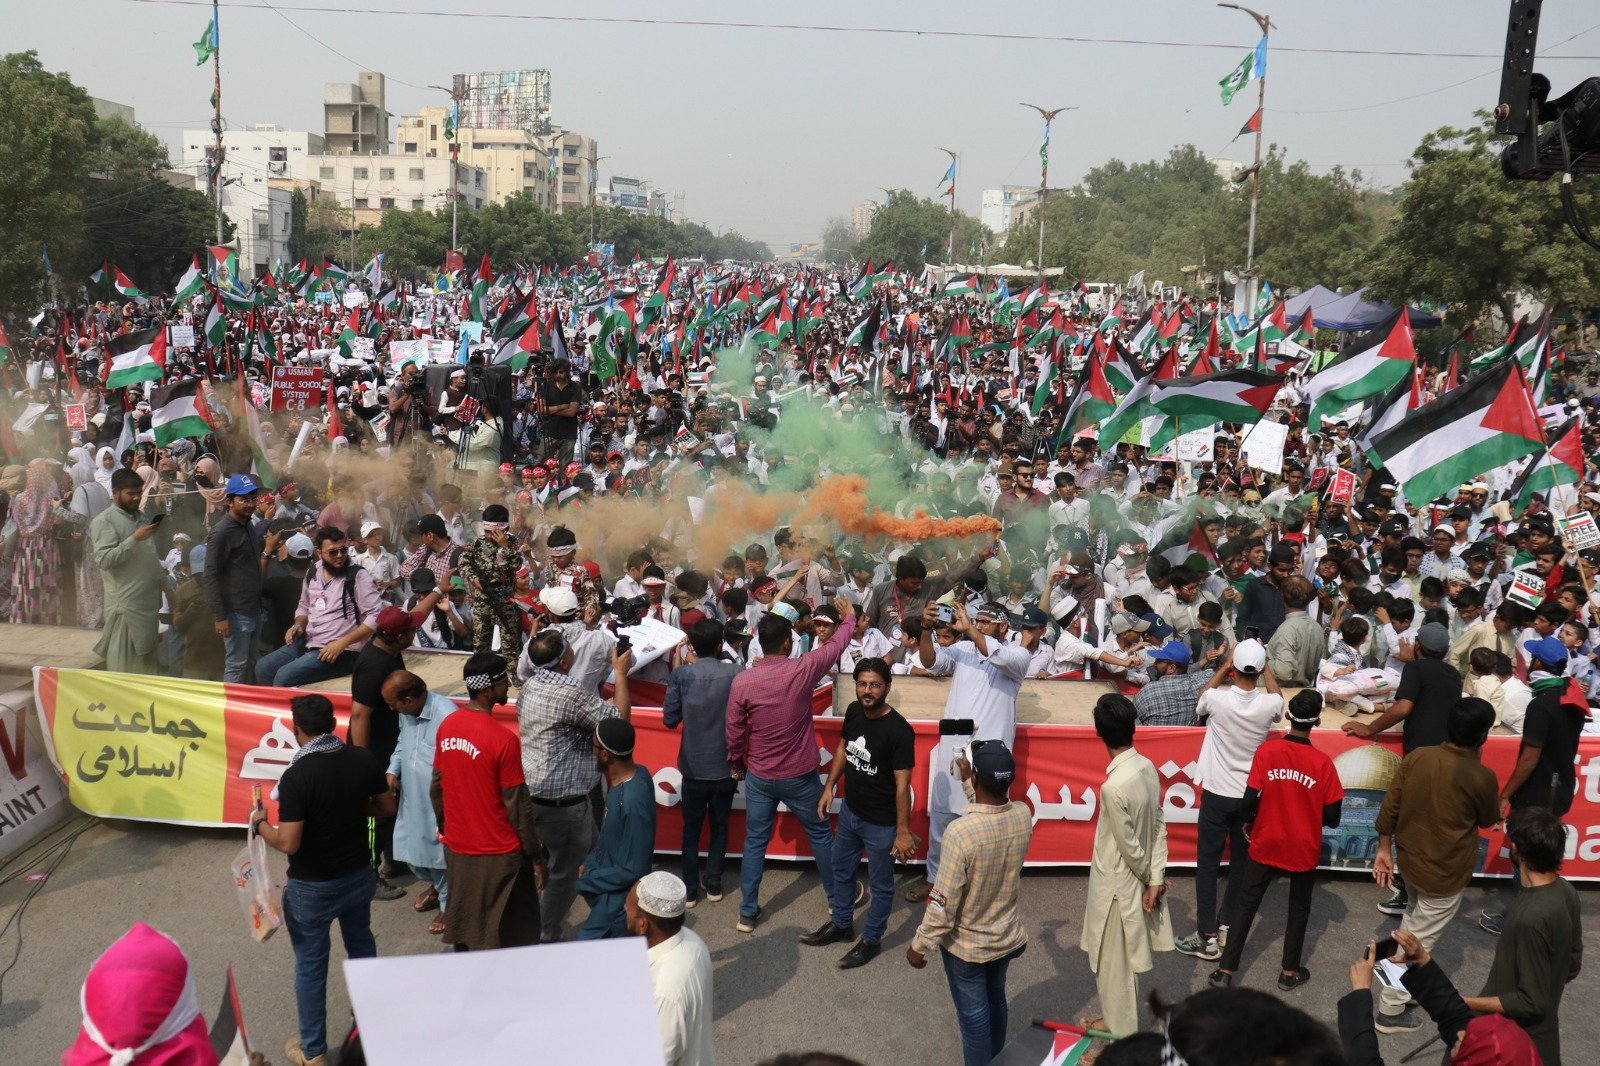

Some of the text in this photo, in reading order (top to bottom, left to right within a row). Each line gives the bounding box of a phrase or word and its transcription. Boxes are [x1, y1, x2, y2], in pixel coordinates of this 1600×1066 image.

[288, 368, 313, 376] USMAN
[274, 380, 323, 390] PUBLIC SCHOOL
[282, 390, 310, 399] SYSTEM
[286, 399, 306, 411] C-8
[1563, 523, 1596, 541] FREE
[1516, 572, 1545, 592] FREE
[73, 701, 207, 752] جماعت
[440, 737, 481, 760] SECURITY
[1267, 768, 1317, 789] SECURITY
